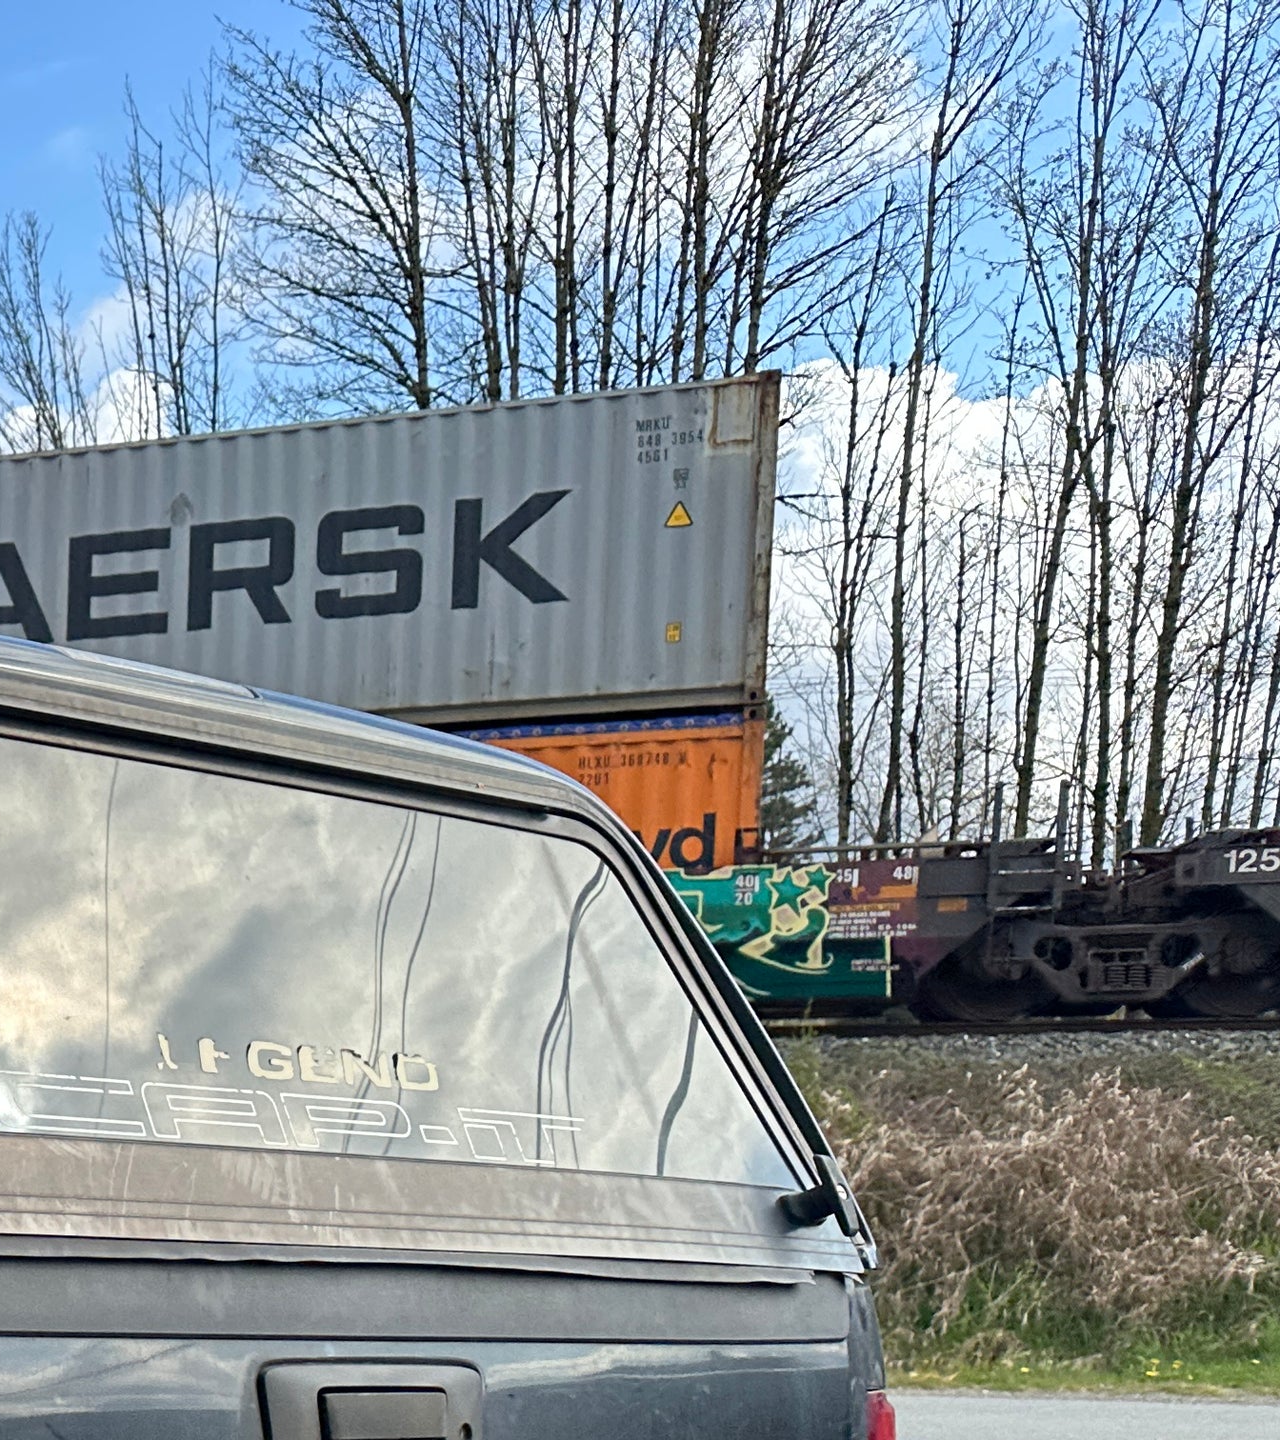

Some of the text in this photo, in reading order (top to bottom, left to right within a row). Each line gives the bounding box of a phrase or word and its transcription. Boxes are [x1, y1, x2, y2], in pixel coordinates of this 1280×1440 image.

[636, 417, 671, 433] MRKU
[893, 866, 913, 880] 48
[735, 874, 754, 887] 40
[735, 892, 753, 906] 20
